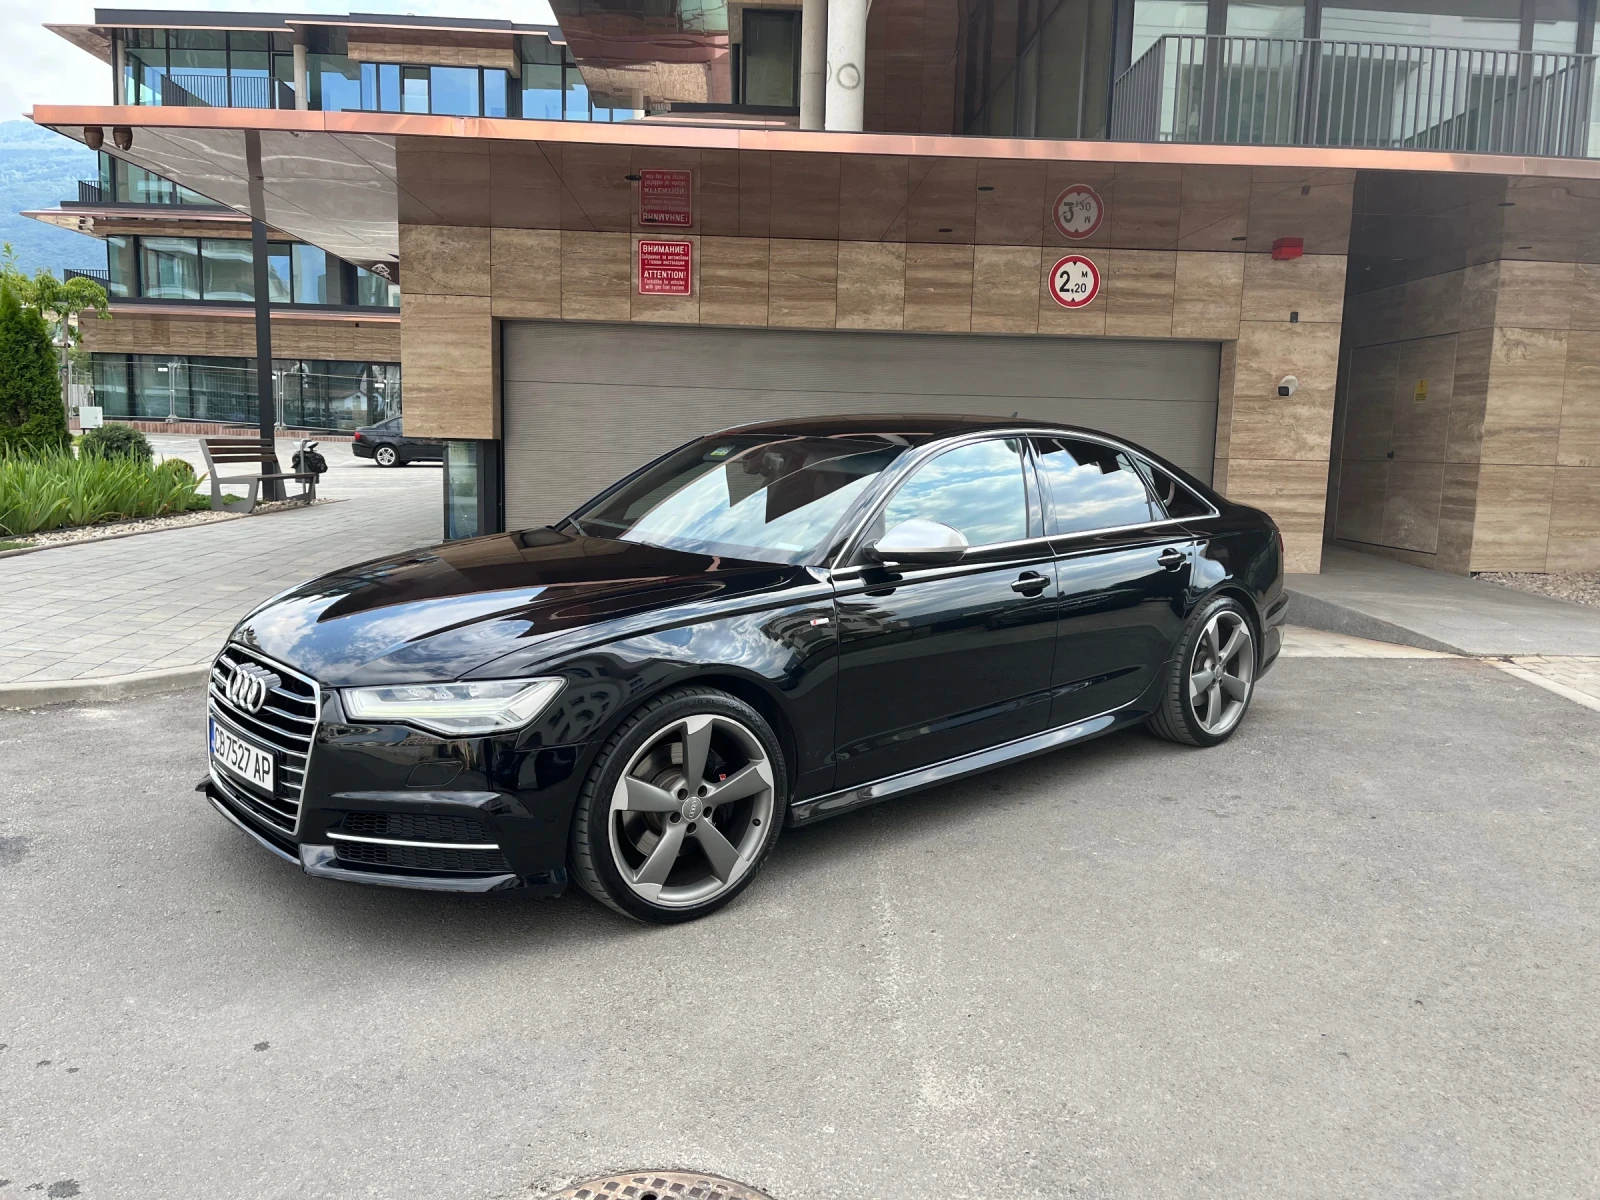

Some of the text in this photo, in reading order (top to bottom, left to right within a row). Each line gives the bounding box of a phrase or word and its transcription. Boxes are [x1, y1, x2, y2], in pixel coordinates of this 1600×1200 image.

[642, 244, 688, 254] ВНИМАНИЕ!
[643, 270, 687, 279] ATTENTION!
[253, 752, 270, 783] AP
